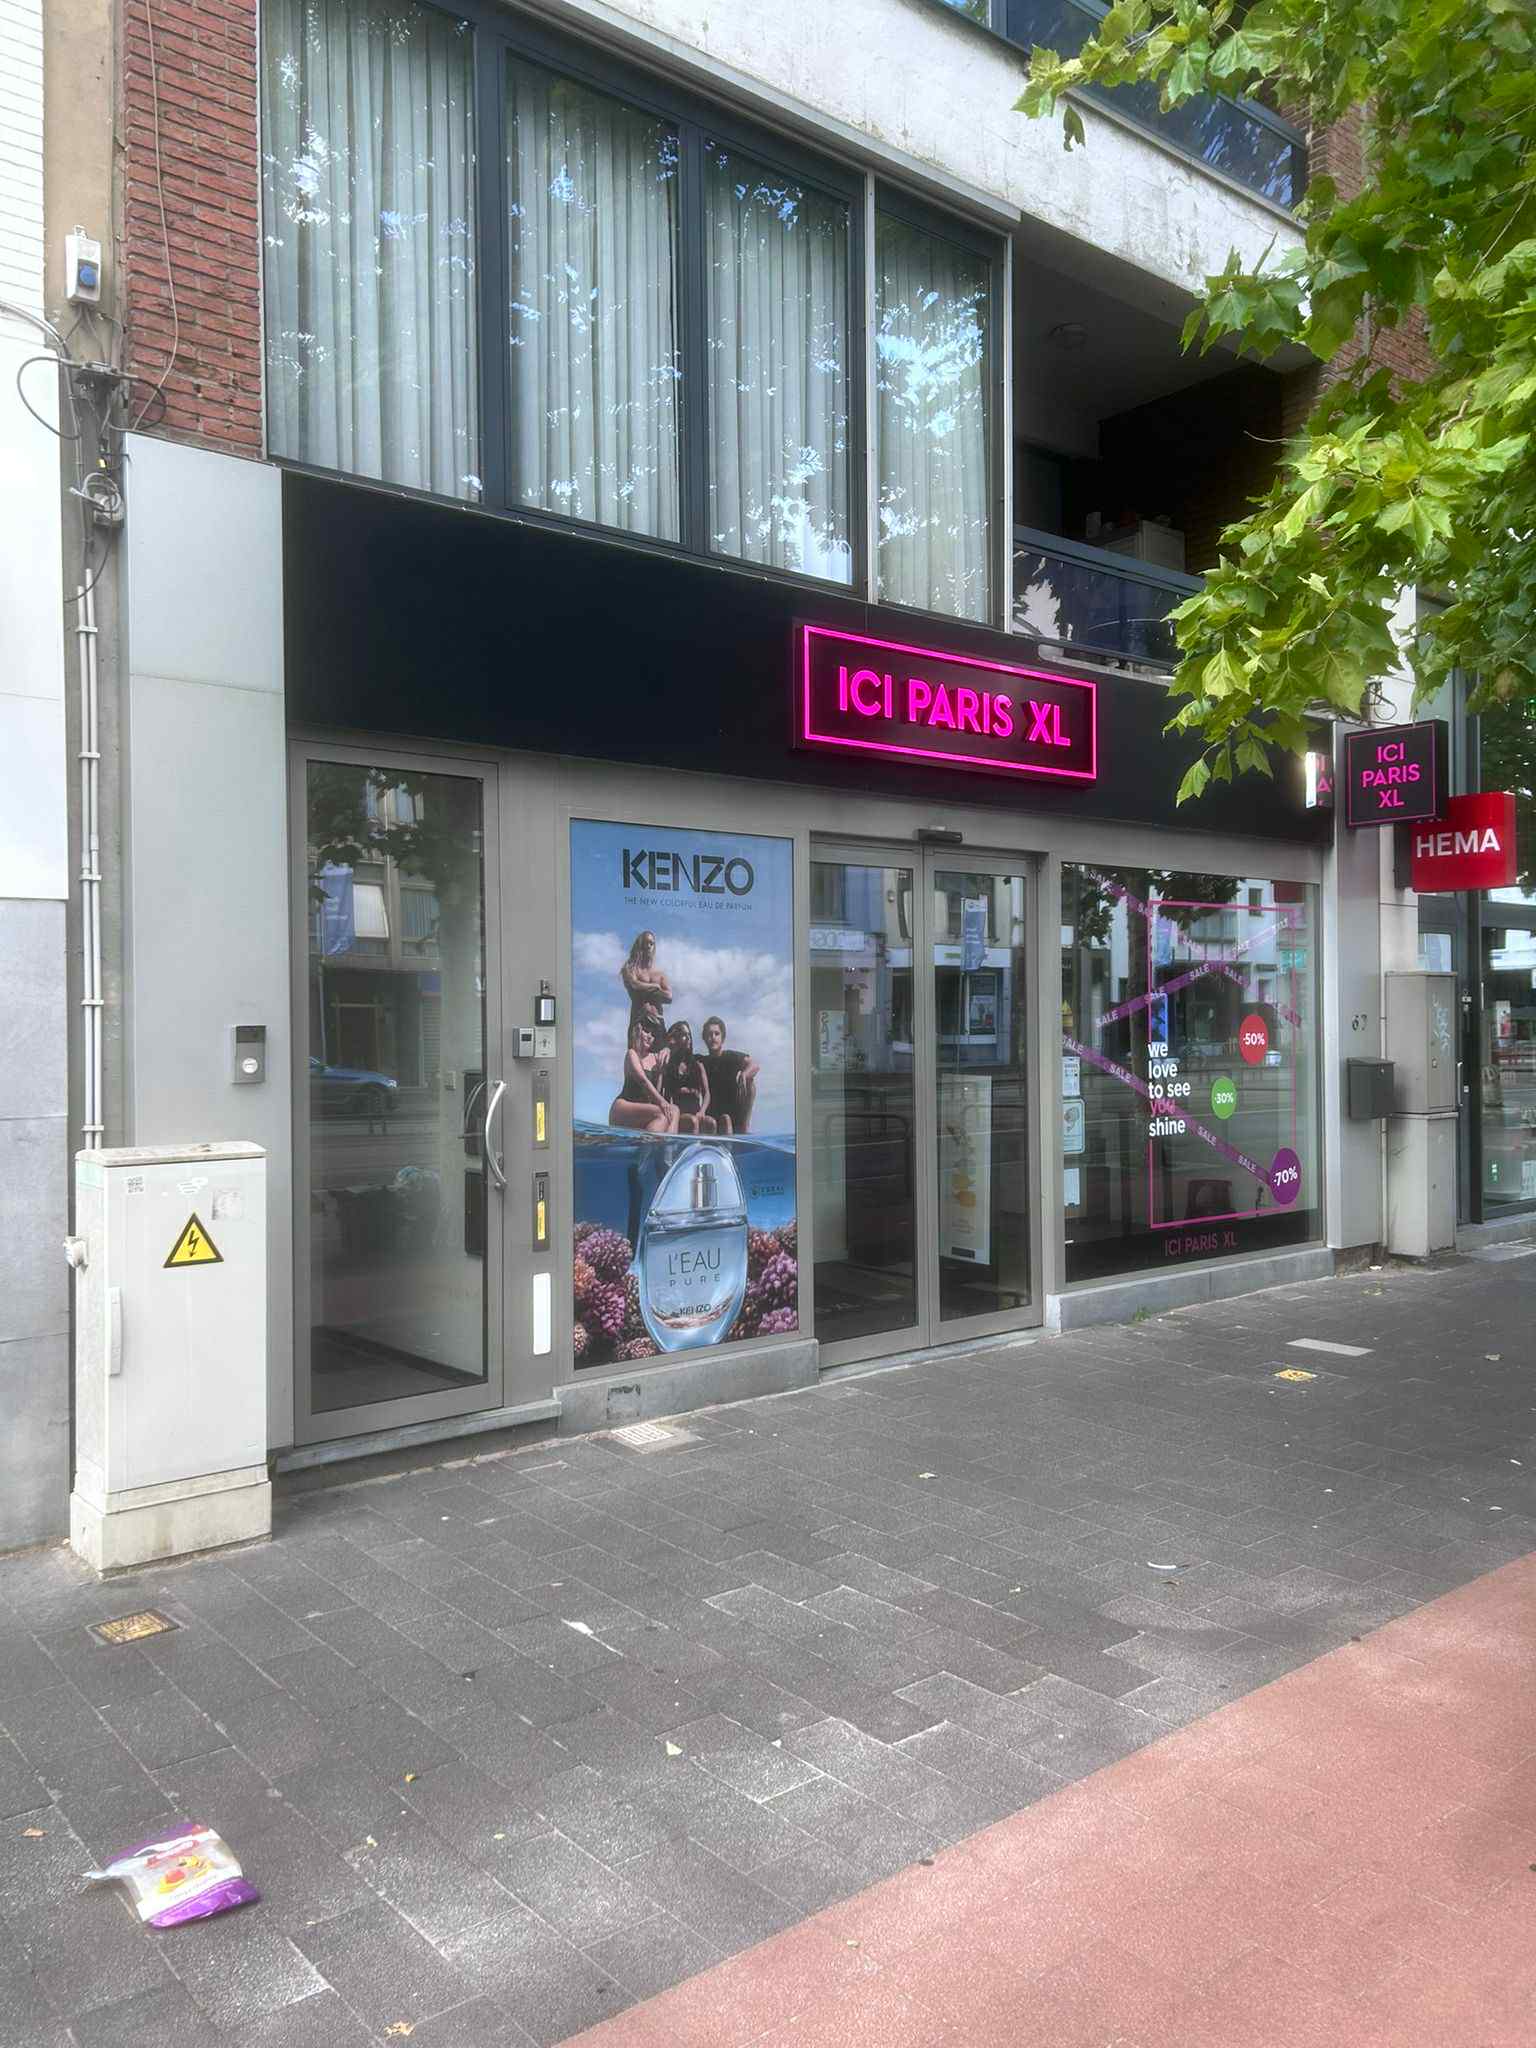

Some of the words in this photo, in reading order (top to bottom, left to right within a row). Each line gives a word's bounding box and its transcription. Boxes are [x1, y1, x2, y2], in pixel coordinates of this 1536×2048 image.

[839, 665, 893, 719] ICI
[908, 678, 1014, 738] PARIS
[1028, 700, 1071, 747] XL
[1377, 742, 1405, 764] ICI
[1362, 763, 1421, 788] PARIS
[1378, 788, 1405, 809] XL
[1416, 827, 1501, 858] HEMA
[622, 848, 755, 897] KENZO
[624, 896, 638, 905] THE
[640, 896, 657, 905] NEW
[1189, 963, 1210, 981] SALE
[1224, 965, 1246, 985] SALE
[1095, 1008, 1120, 1029] SALE
[1242, 1032, 1266, 1046] -50%
[1147, 1042, 1169, 1058] we
[1109, 1063, 1133, 1084] SALE
[1148, 1060, 1179, 1080] love
[1148, 1082, 1164, 1099] to
[1167, 1082, 1191, 1098] see
[1214, 1092, 1234, 1105] -30%
[1150, 1098, 1176, 1118] you
[1149, 1116, 1187, 1137] shine
[1198, 1126, 1217, 1147] SALE
[1237, 1154, 1257, 1174] SALE
[1273, 1165, 1298, 1187] -70%
[1164, 1239, 1181, 1257] ICI
[1185, 1232, 1218, 1253] PARIS
[1223, 1231, 1239, 1249] XL
[668, 1247, 721, 1276] L'EAU
[669, 1273, 721, 1288] PURE
